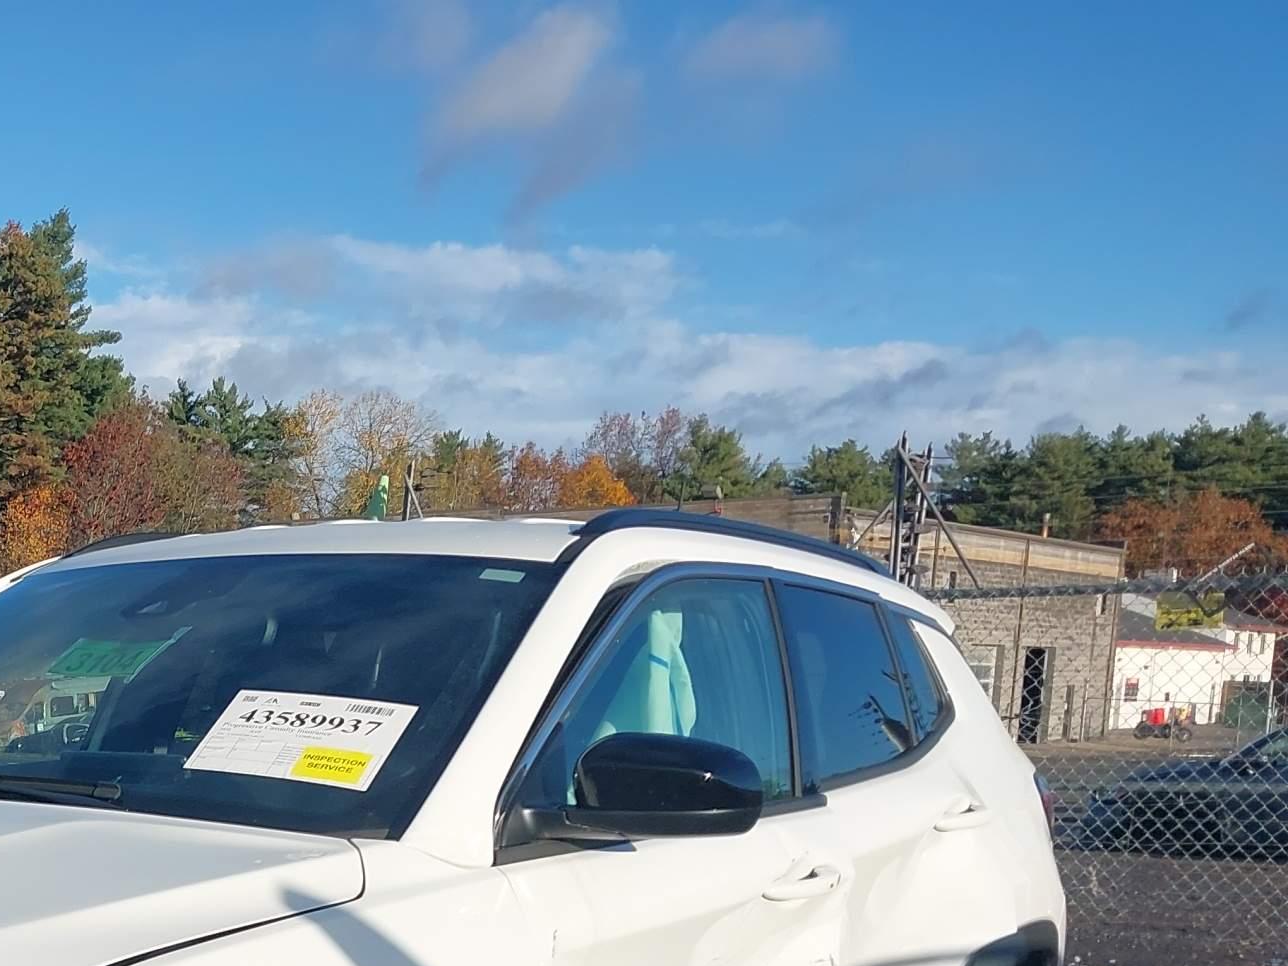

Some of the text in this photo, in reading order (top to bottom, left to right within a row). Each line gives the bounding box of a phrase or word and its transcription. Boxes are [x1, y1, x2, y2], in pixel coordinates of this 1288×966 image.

[239, 708, 384, 737] 43589937
[303, 753, 367, 767] INSPECTION
[305, 761, 354, 774] SERVICE
